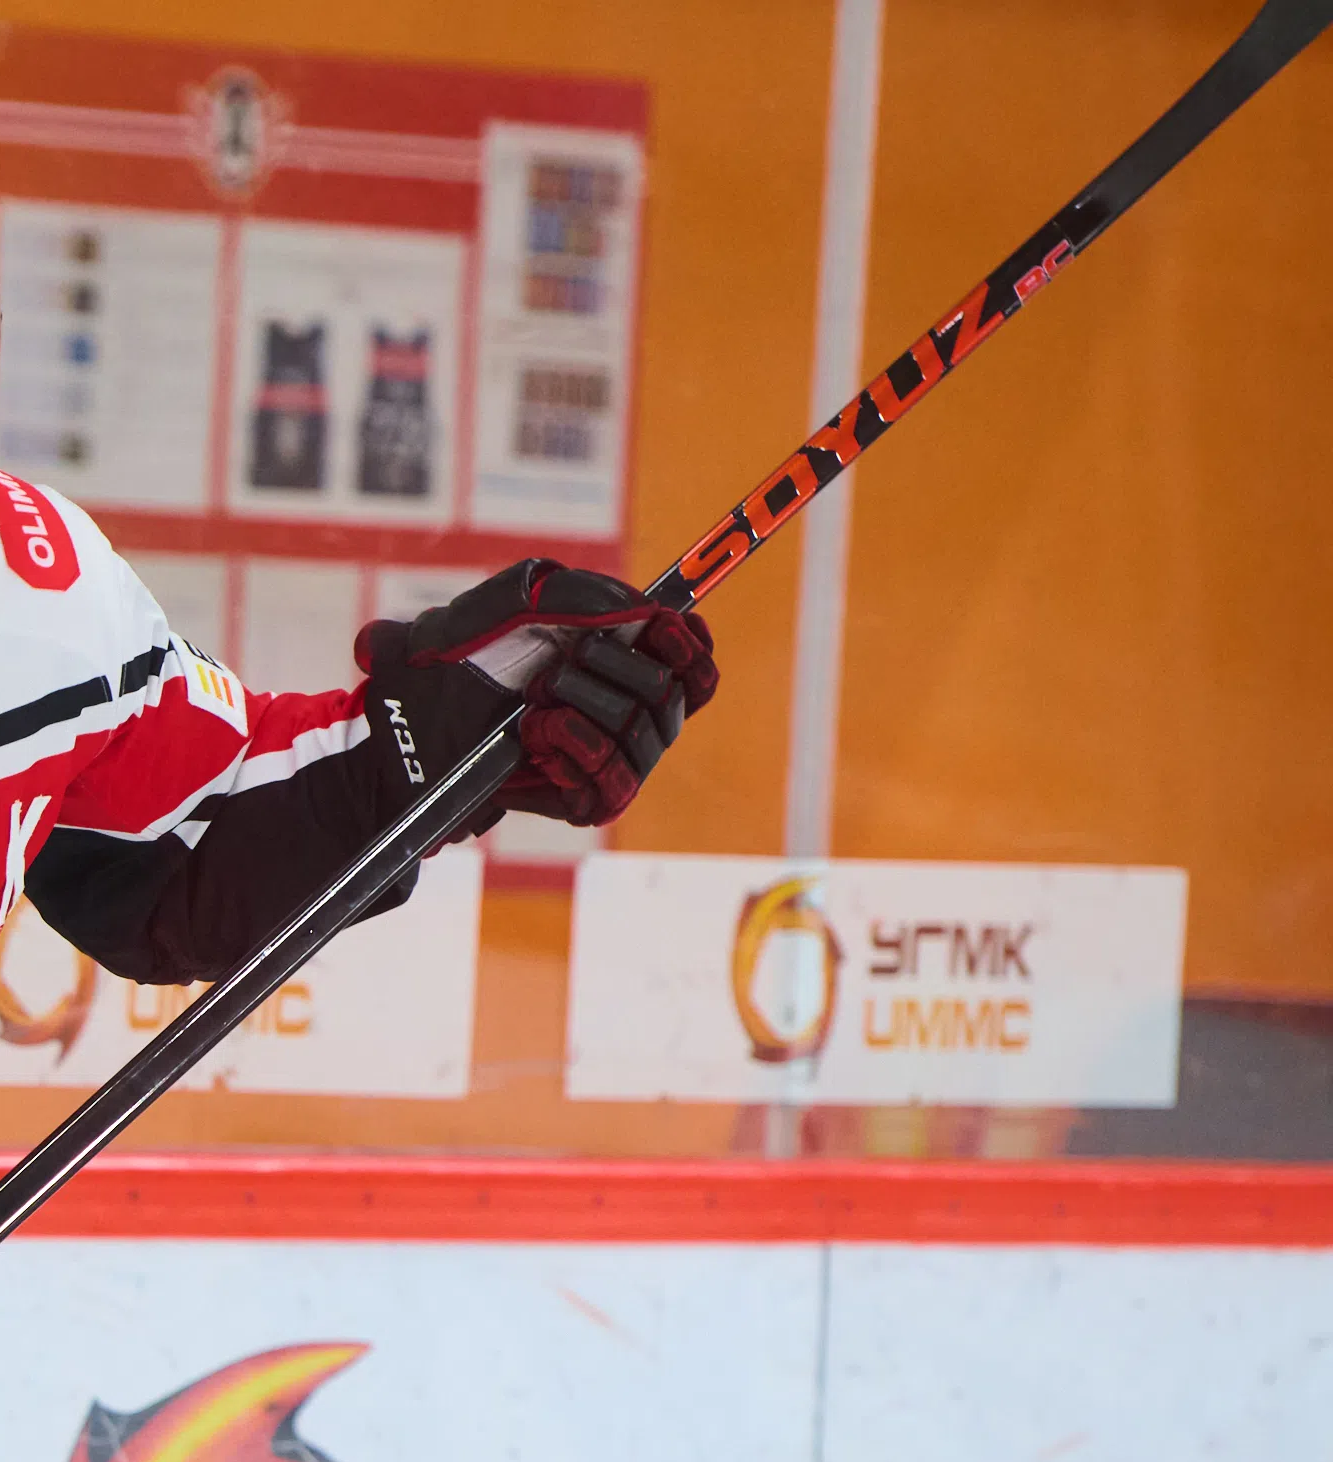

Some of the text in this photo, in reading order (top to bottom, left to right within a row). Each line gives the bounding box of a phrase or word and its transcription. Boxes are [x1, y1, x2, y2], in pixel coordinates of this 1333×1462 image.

[678, 281, 1006, 601] SOYUZ
[383, 698, 425, 784] CCM
[869, 921, 1033, 979] УГМК
[862, 997, 1030, 1049] UMMC
